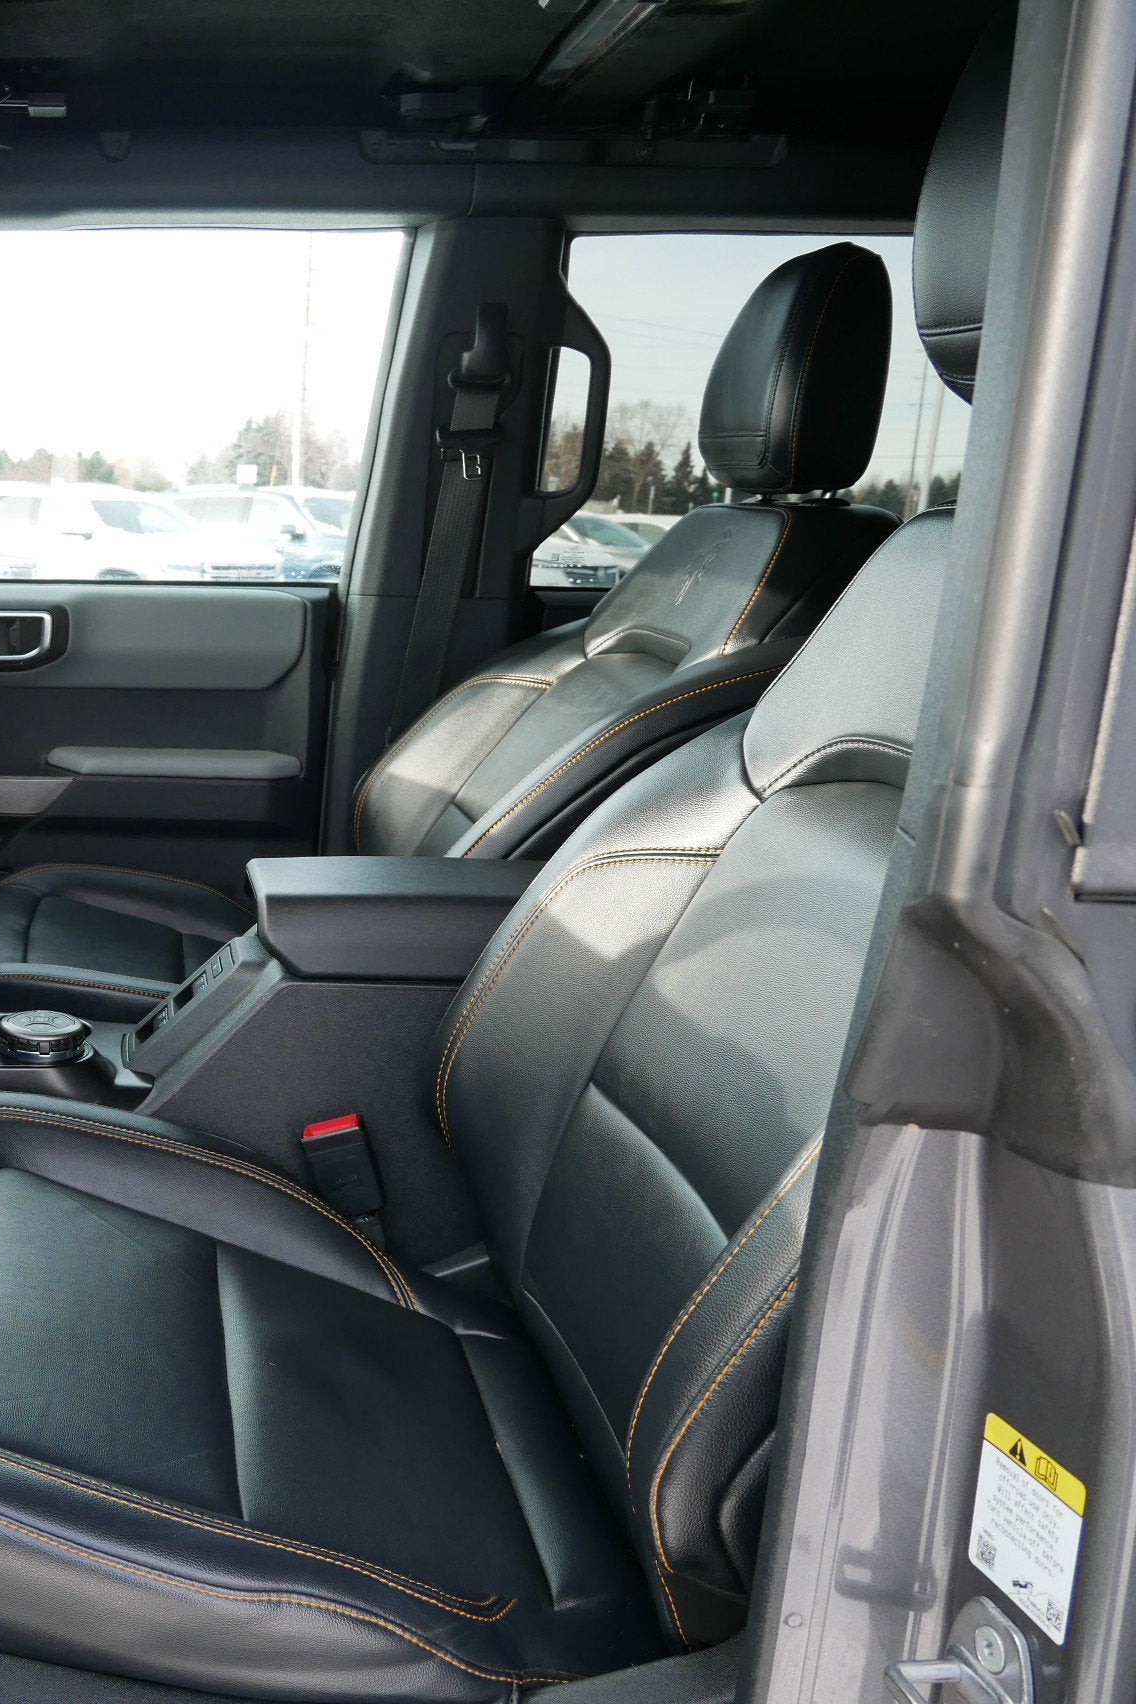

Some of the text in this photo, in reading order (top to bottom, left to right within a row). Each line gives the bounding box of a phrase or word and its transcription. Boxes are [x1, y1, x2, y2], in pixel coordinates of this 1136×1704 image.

[992, 1492, 1013, 1517] system
[996, 1483, 1011, 1501] Will
[1036, 1518, 1059, 1544] safety
[1031, 1486, 1050, 1508] doors
[986, 1498, 1001, 1518] Turn
[1003, 1514, 1026, 1541] vehicle
